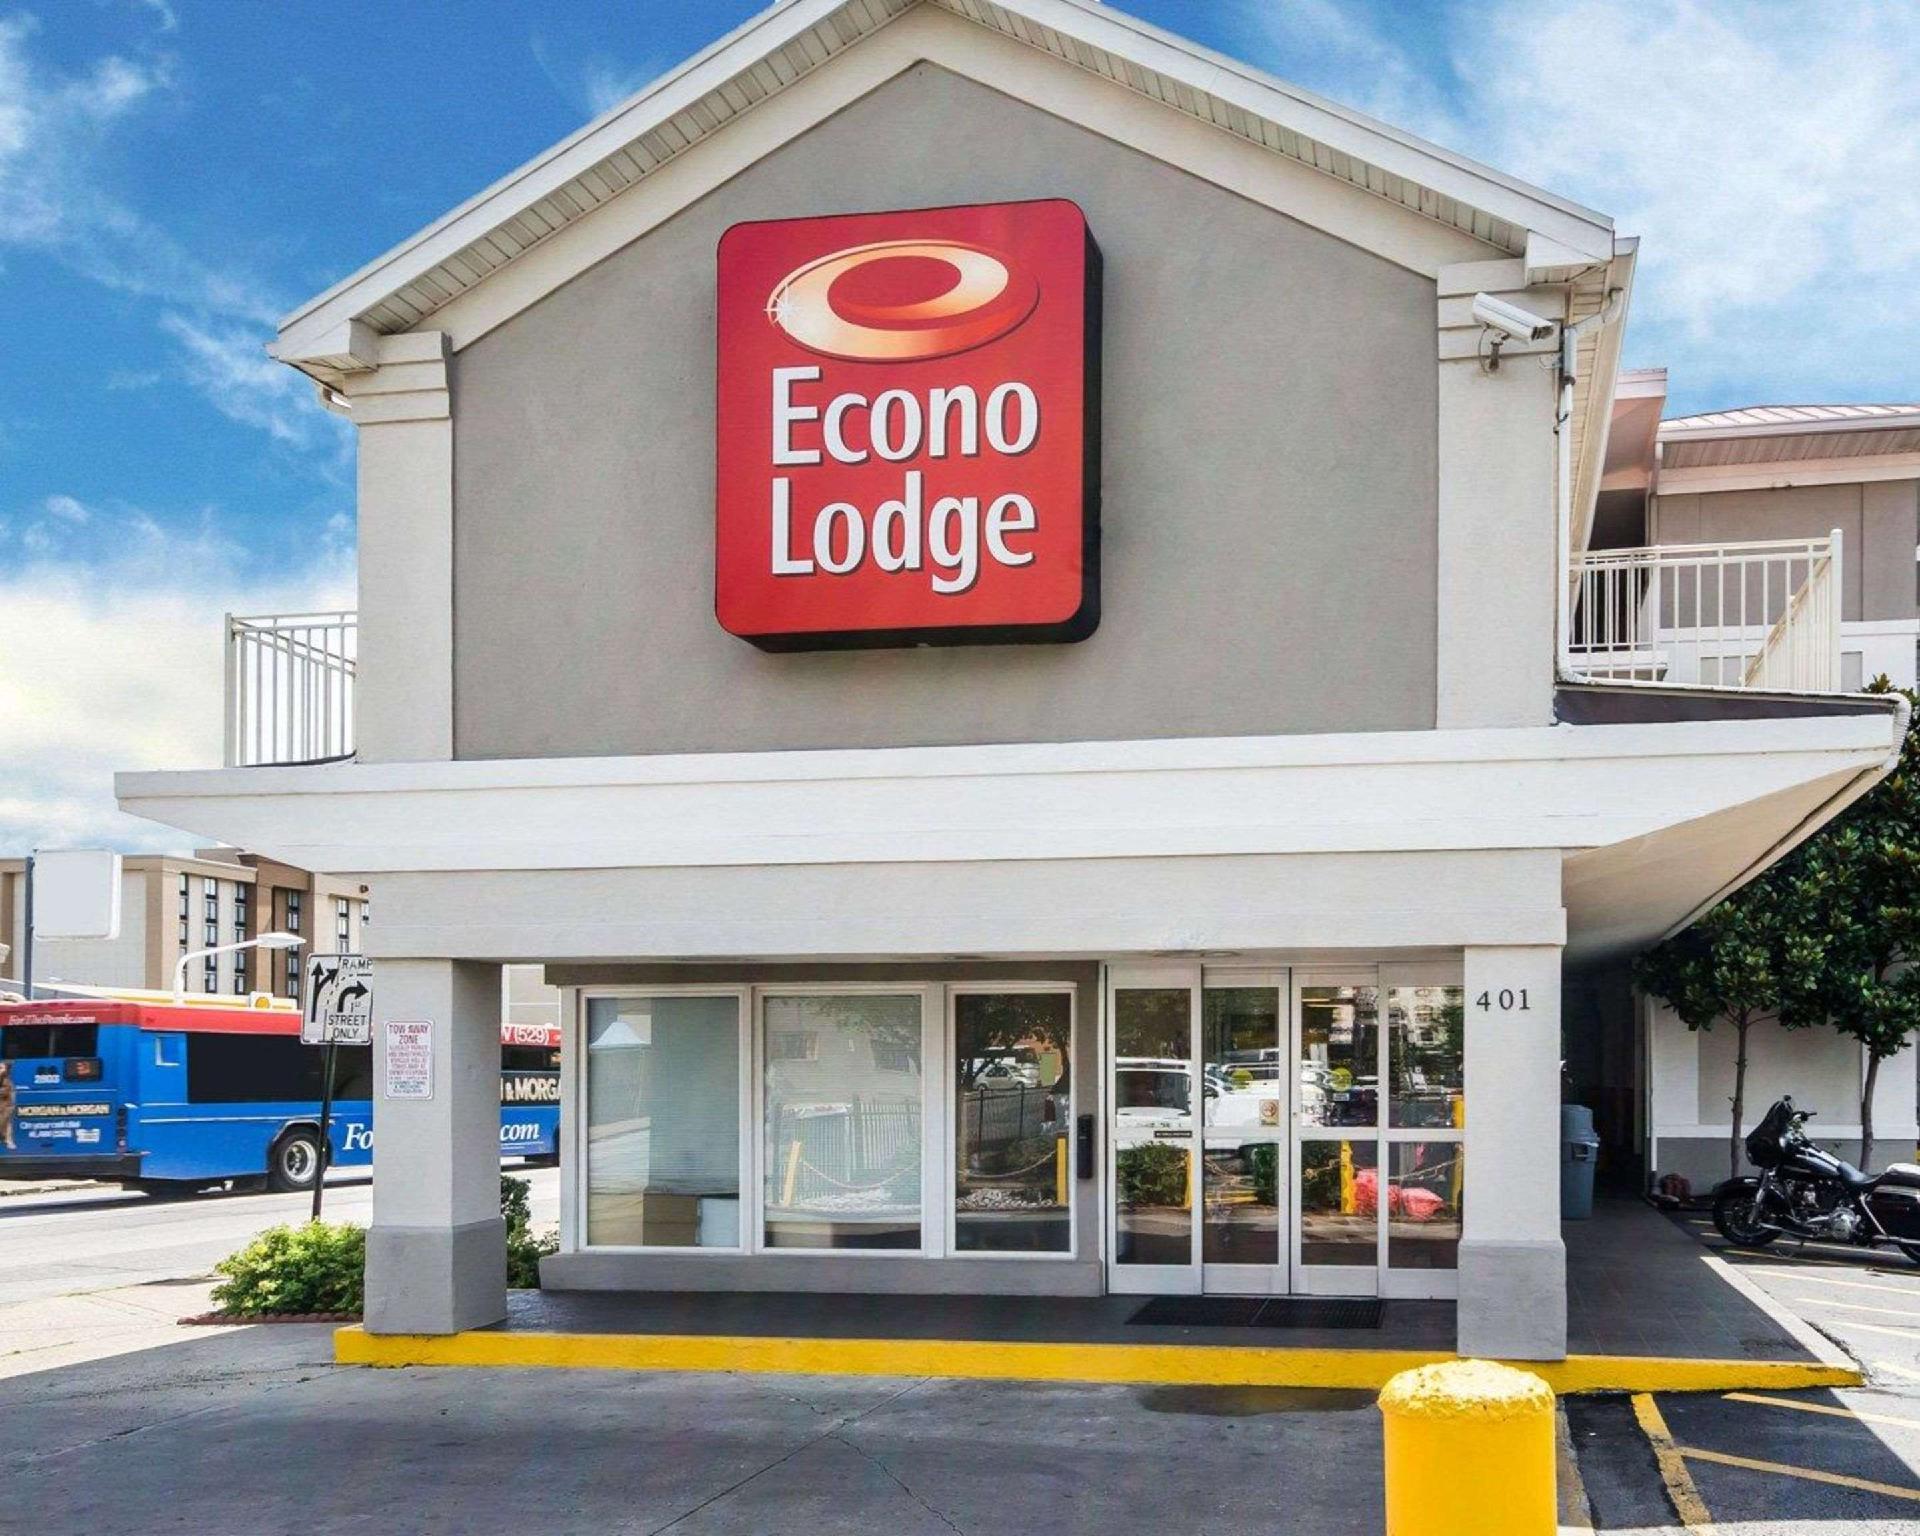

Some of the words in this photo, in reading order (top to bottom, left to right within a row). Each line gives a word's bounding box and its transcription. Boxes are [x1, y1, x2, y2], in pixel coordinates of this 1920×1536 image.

[772, 366, 1039, 465] Econo
[772, 470, 1036, 593] Lodge
[342, 959, 373, 970] RAMP
[1476, 988, 1530, 1012] 401
[328, 1015, 367, 1026] STREET
[333, 1028, 359, 1039] ONLY
[389, 1024, 406, 1034] TOW
[408, 1024, 428, 1034] AWAY
[513, 1025, 550, 1045] (529)
[399, 1034, 418, 1045] ZONE
[342, 1123, 374, 1150] Fo
